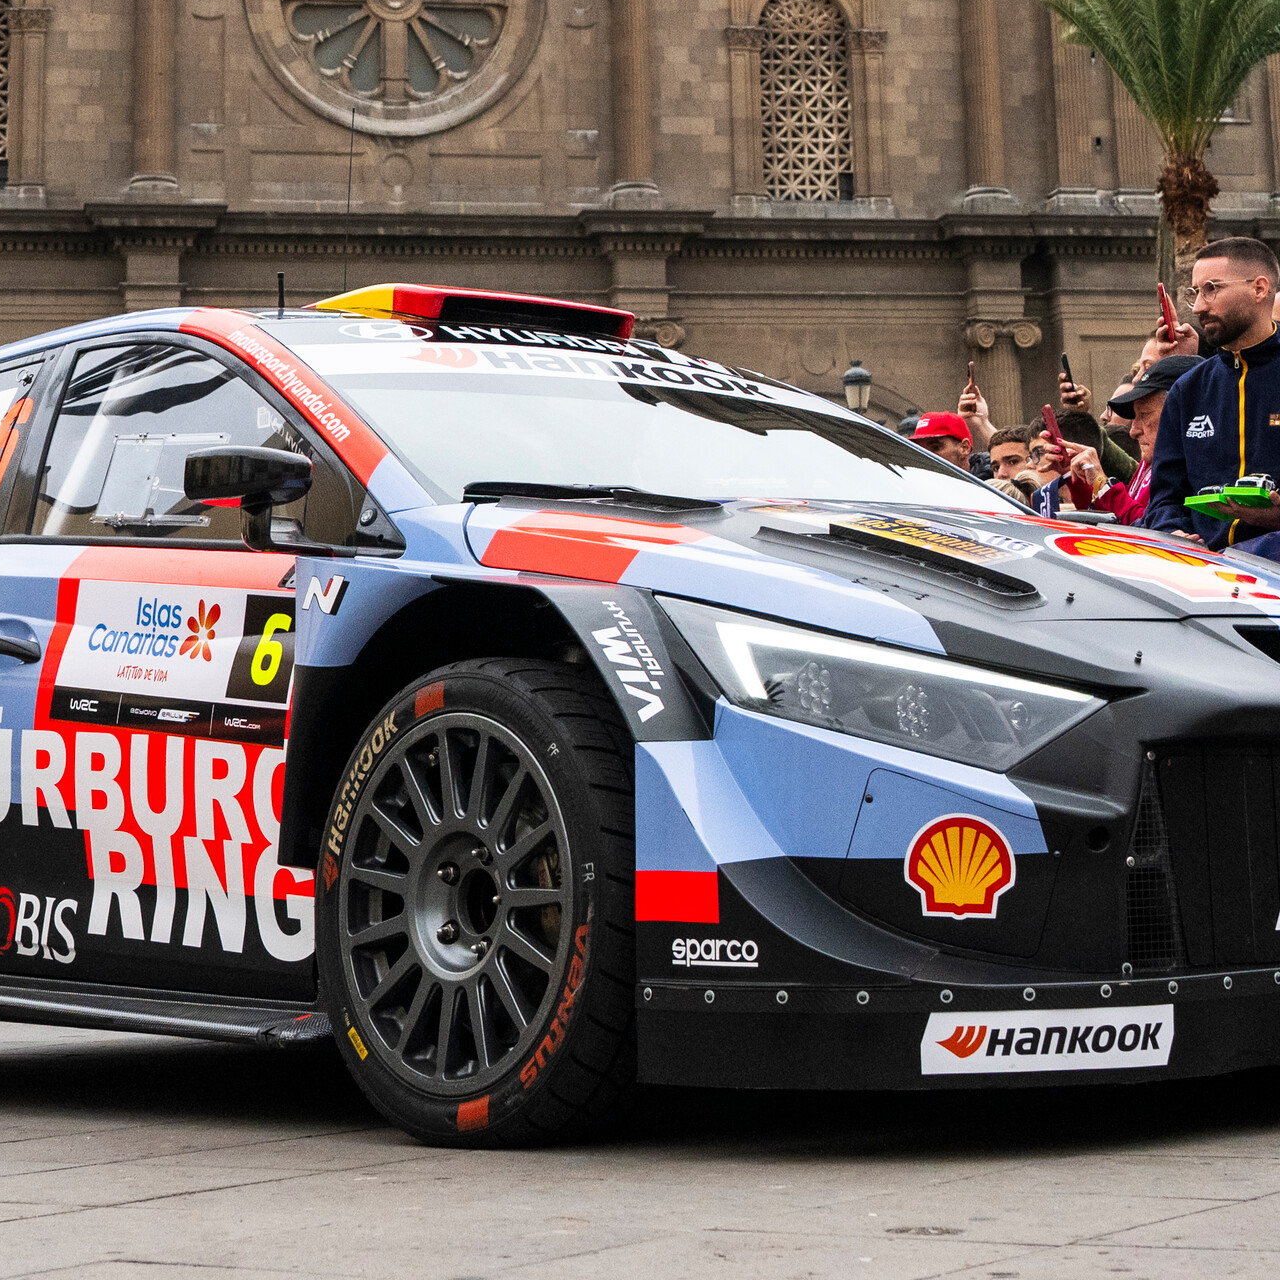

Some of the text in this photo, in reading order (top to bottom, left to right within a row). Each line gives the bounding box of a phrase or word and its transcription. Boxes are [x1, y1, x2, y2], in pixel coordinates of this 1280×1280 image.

[438, 325, 650, 358] HYUNDAI
[228, 330, 351, 442] motorsport.hyundai.com
[1186, 429, 1215, 439] SPORTS
[1187, 415, 1214, 431] EA
[136, 597, 182, 628] Islas
[88, 623, 180, 658] Canarias
[250, 613, 292, 686] 6
[601, 600, 665, 676] HYUNDAI
[116, 666, 168, 682] LATITUD DE VIDA
[591, 626, 665, 723] WIA
[70, 697, 99, 713] WRC
[130, 707, 183, 720] BEYOND RALLY
[88, 830, 316, 963] RING
[671, 937, 759, 968] sparco
